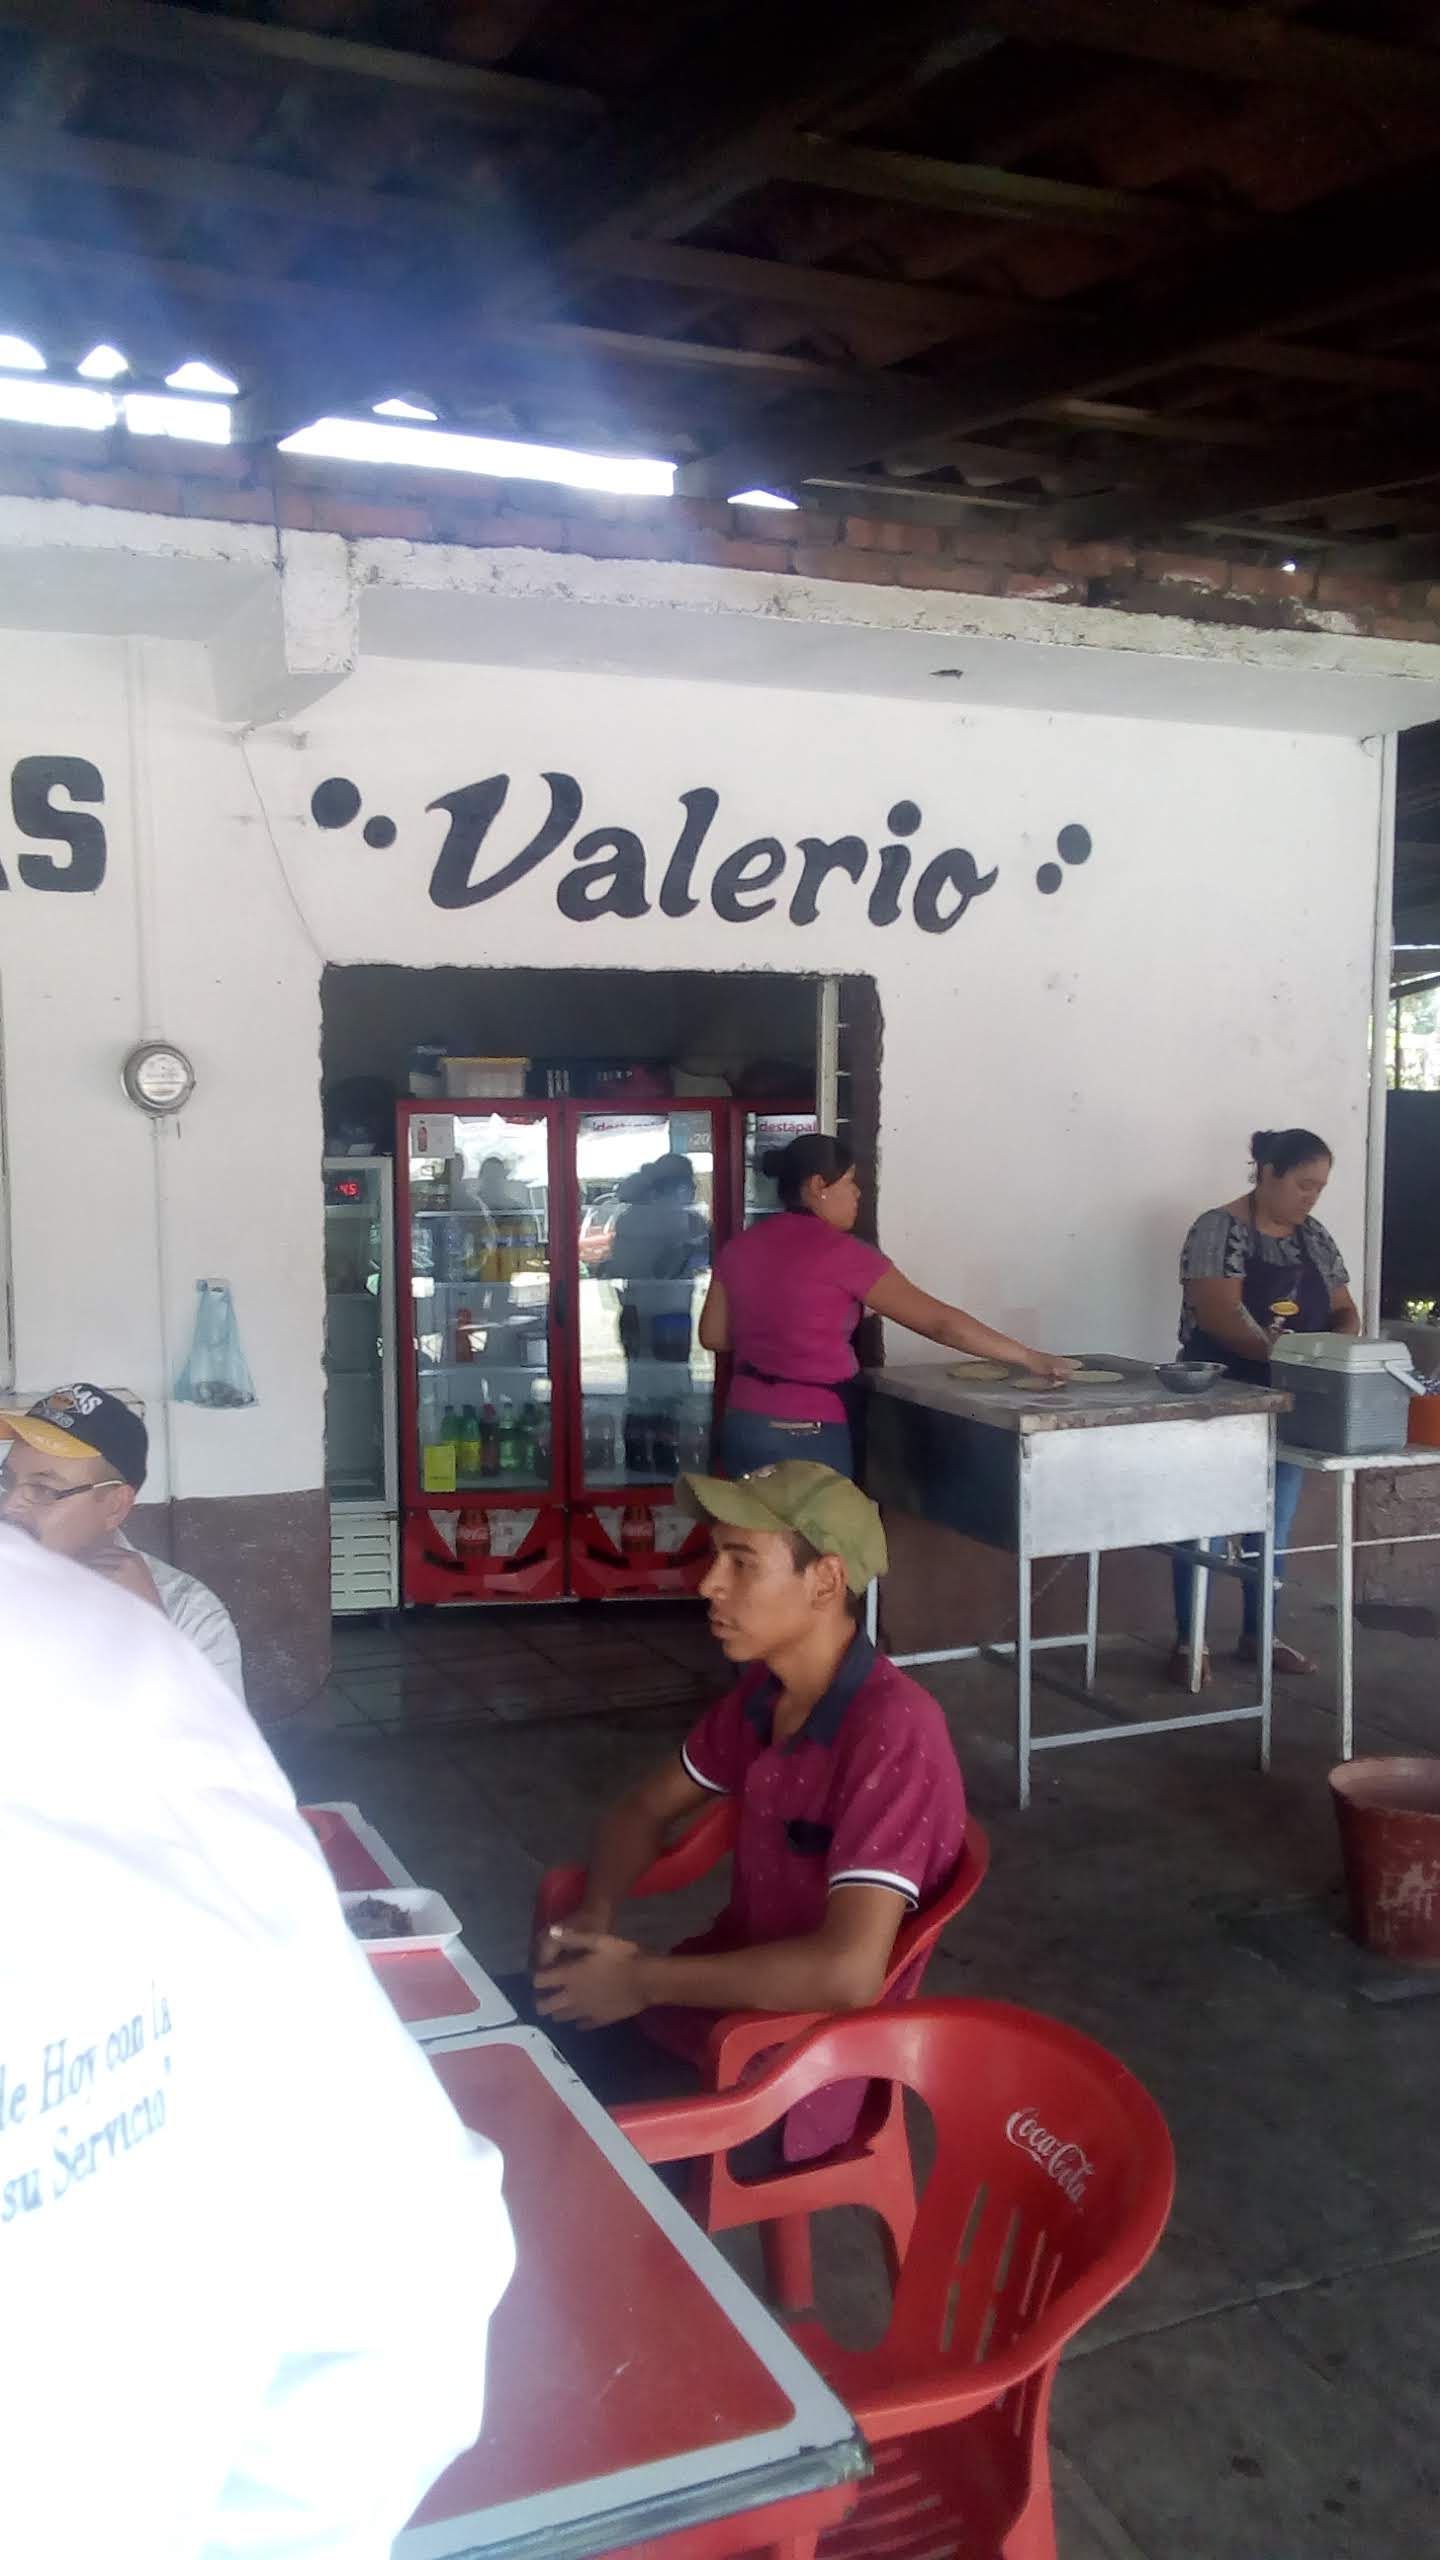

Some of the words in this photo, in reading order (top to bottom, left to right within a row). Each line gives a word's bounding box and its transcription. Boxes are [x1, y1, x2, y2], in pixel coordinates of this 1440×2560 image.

[0, 755, 107, 894] S
[426, 772, 999, 935] Valerio
[1, 2168, 43, 2223] su
